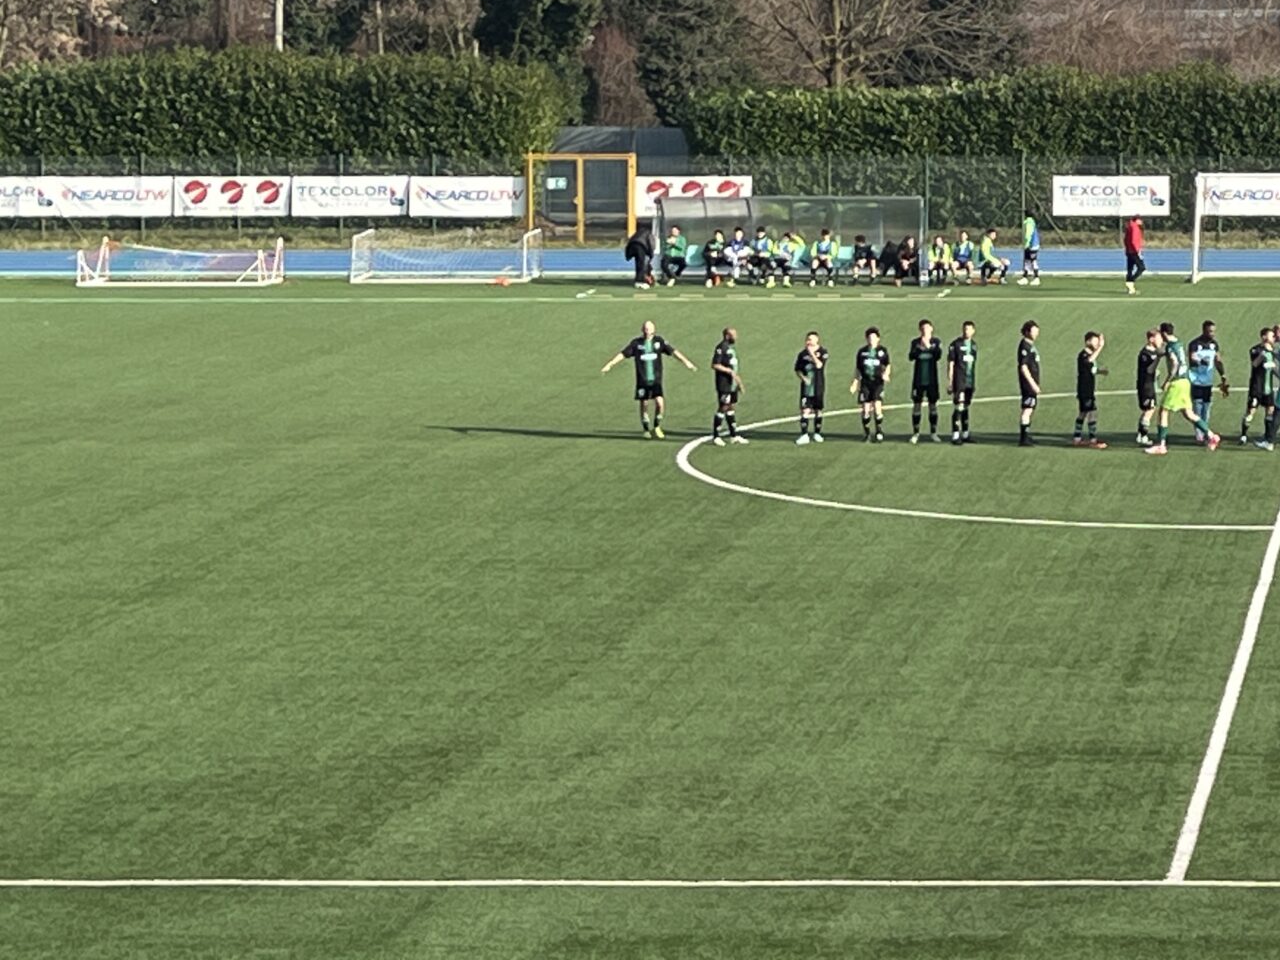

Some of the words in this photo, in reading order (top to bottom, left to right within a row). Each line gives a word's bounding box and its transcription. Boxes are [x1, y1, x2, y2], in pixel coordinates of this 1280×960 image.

[0, 186, 36, 198] LOR
[296, 185, 388, 197] TEXCOLOR
[1059, 185, 1148, 197] TEXCOLOR
